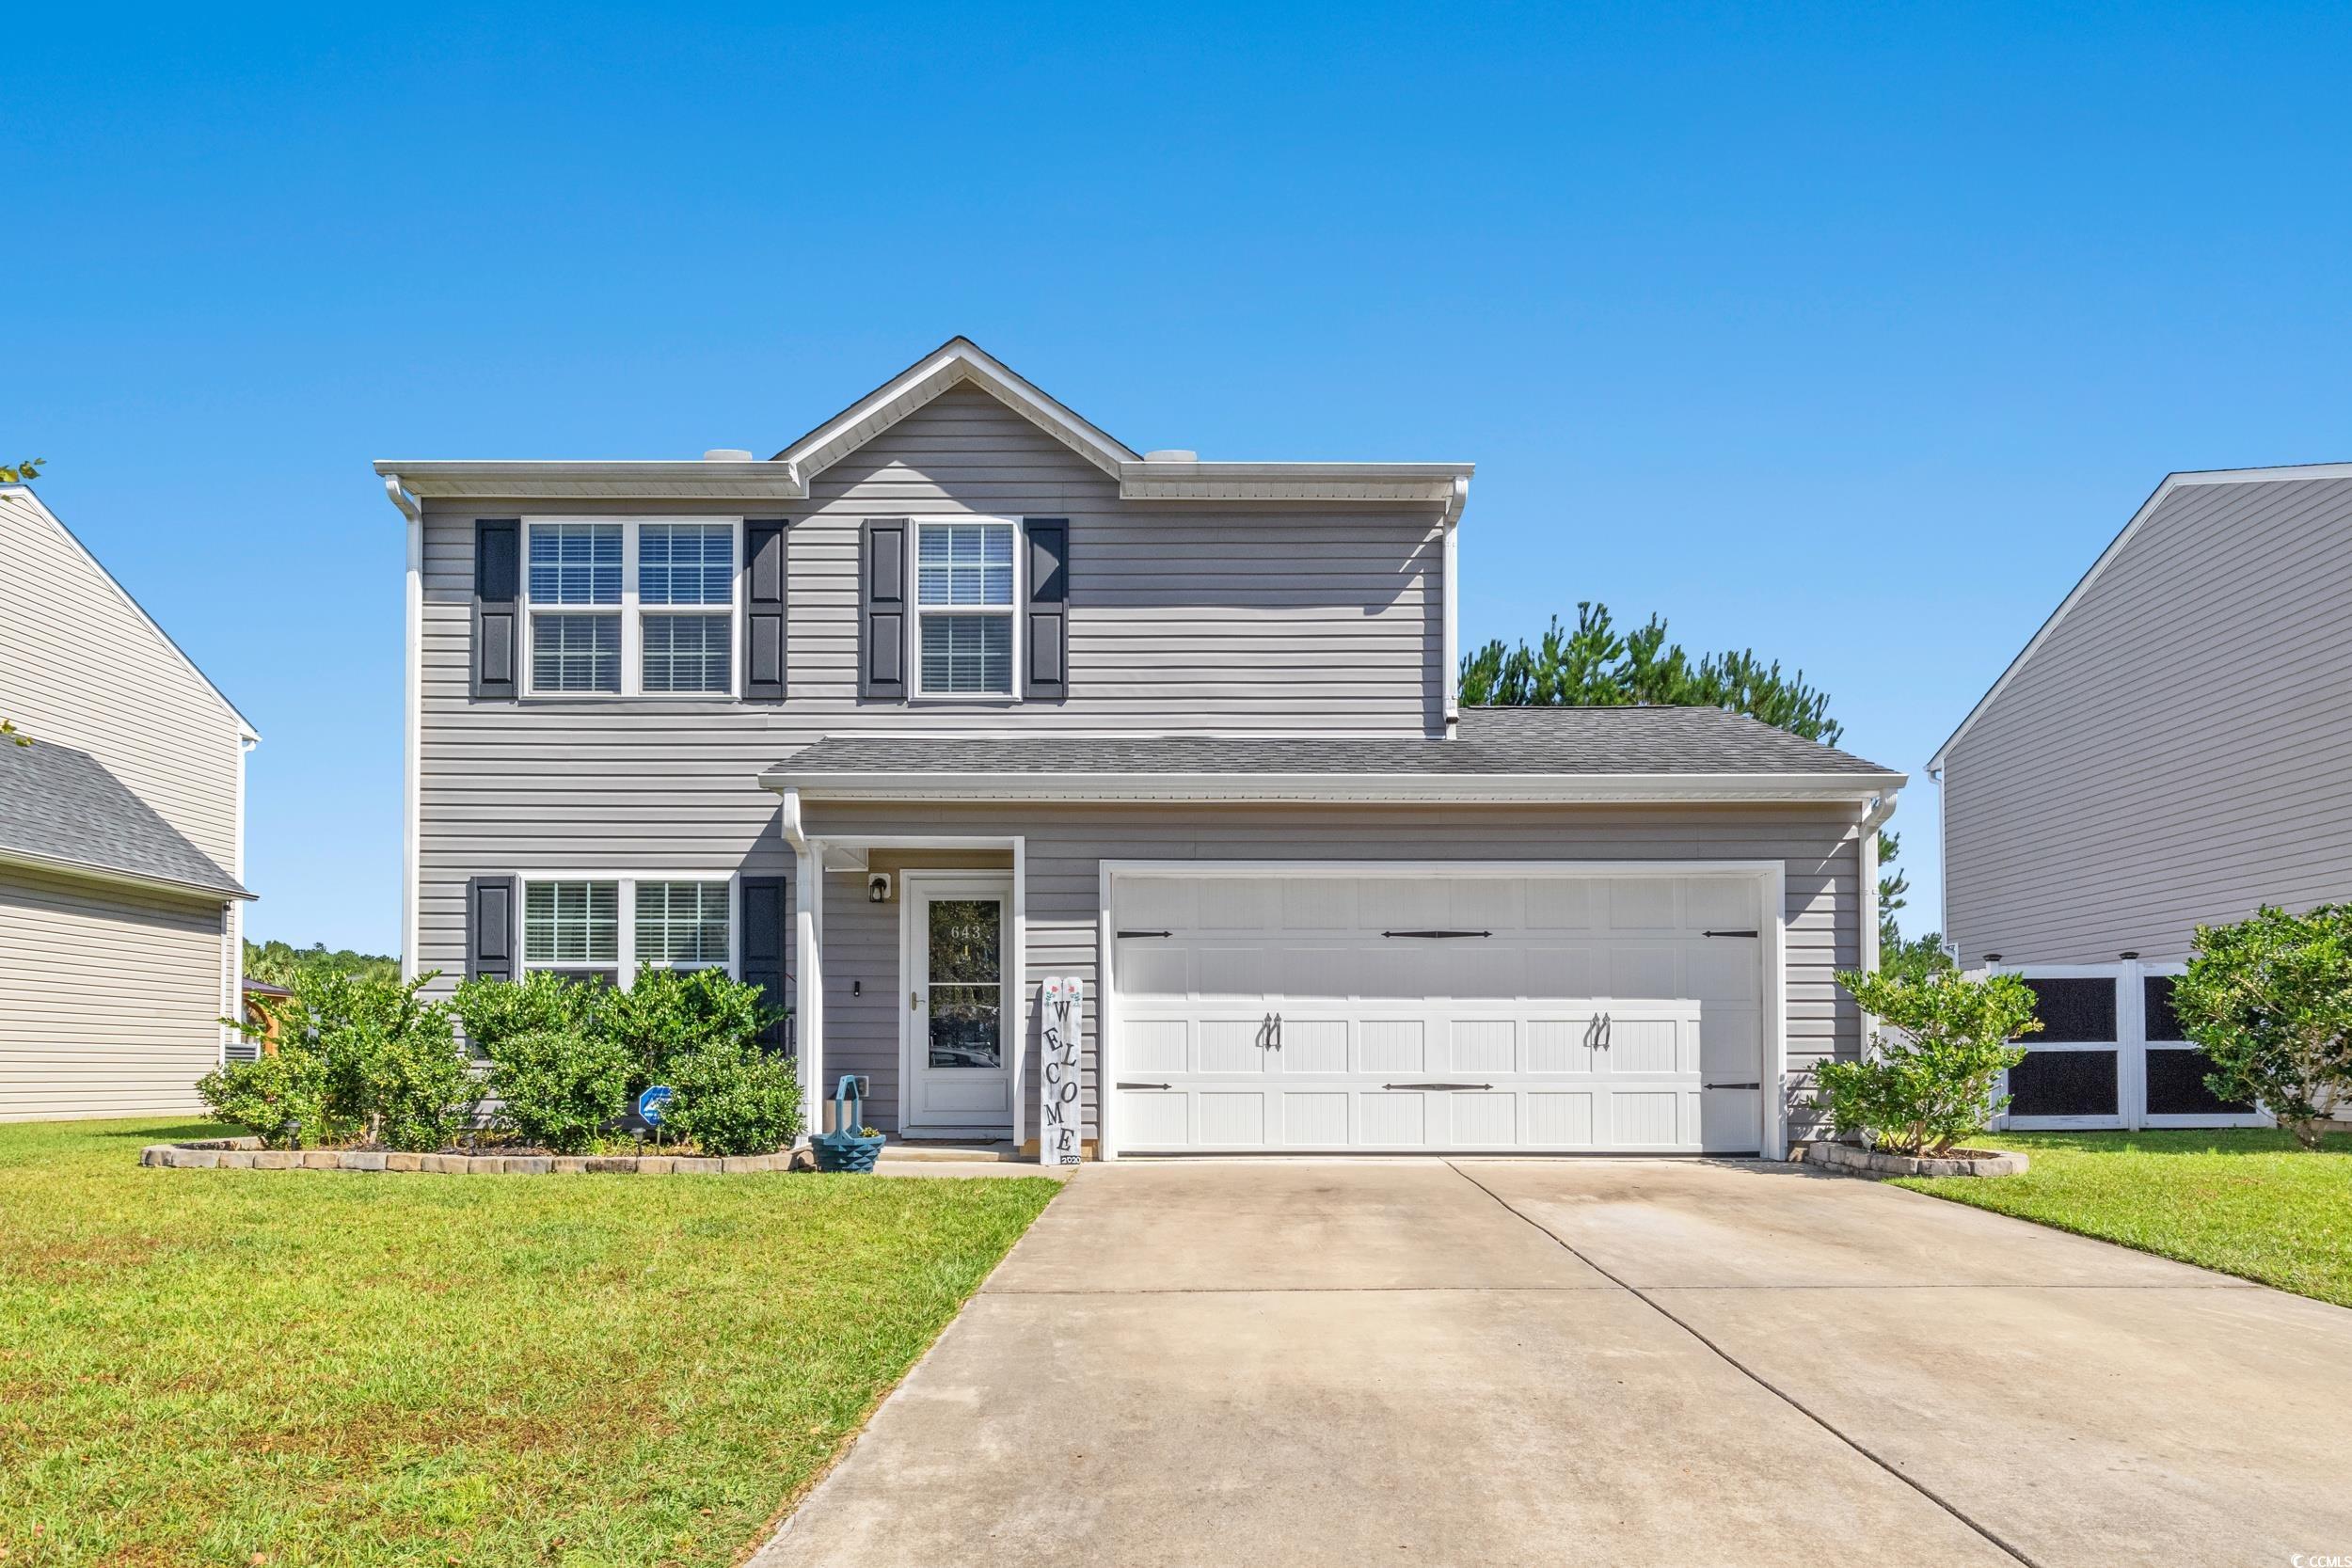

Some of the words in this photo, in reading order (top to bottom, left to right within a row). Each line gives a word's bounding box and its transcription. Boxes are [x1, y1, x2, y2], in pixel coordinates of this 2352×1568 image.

[951, 926, 980, 939] 643
[1042, 1000, 1078, 1152] WELCOME
[1061, 1156, 1081, 1164] 2020
